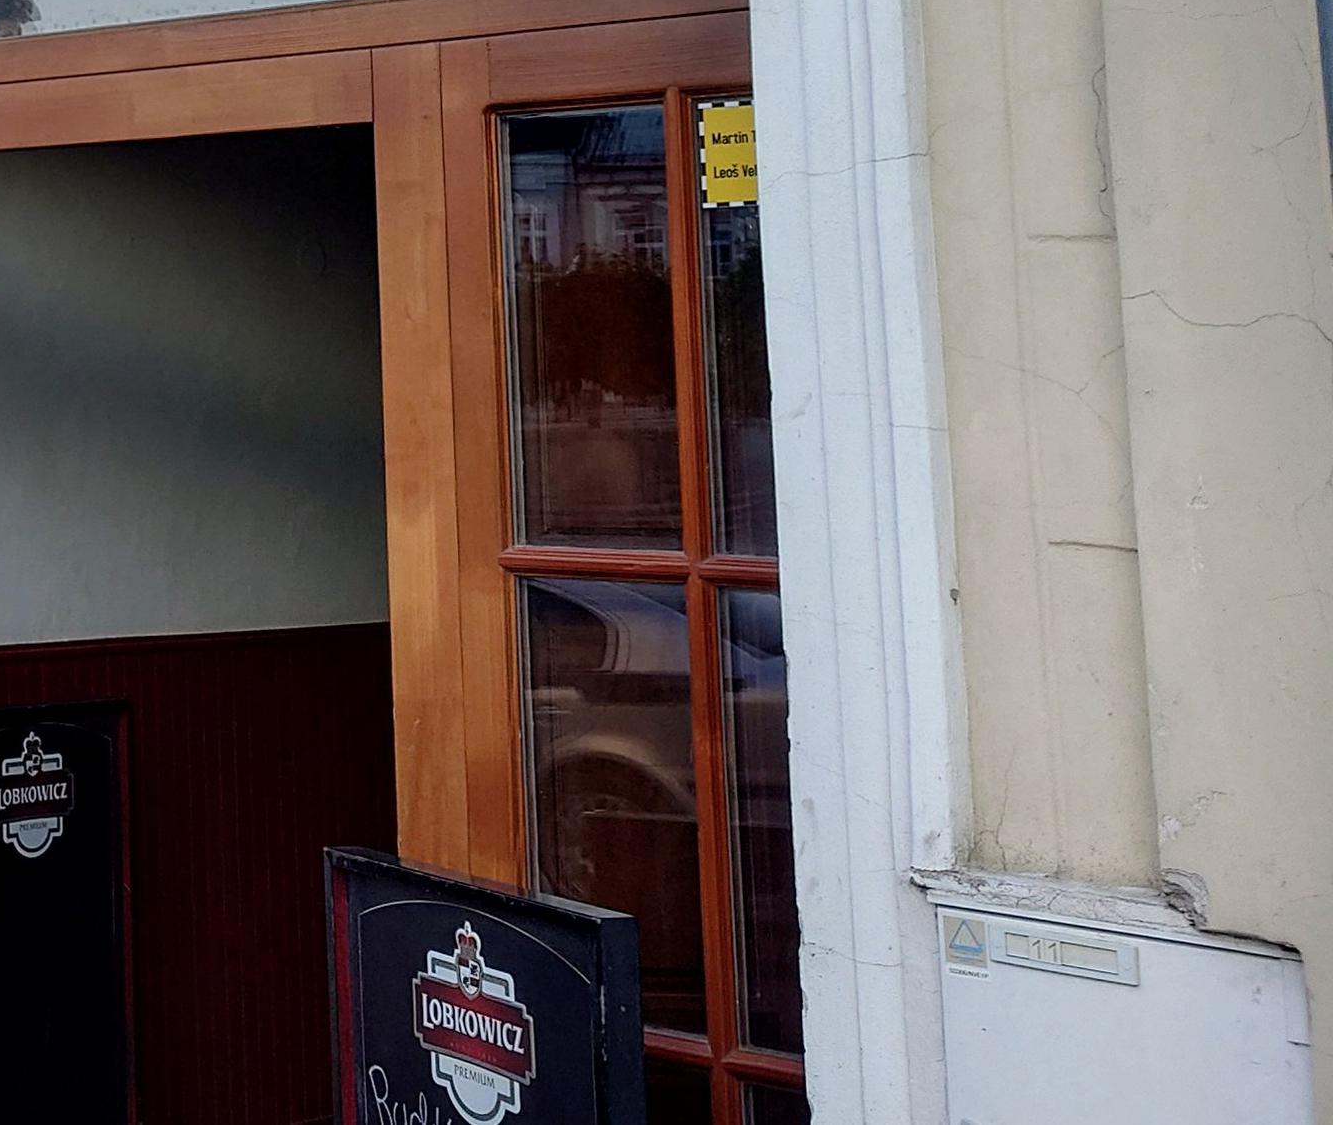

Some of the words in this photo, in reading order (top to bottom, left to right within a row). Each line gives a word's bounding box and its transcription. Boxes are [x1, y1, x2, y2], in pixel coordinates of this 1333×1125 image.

[712, 131, 748, 145] Martin
[713, 164, 739, 179] Leoš
[421, 992, 525, 1054] LOBKOWICZ
[454, 1064, 496, 1088] PREMIUM
